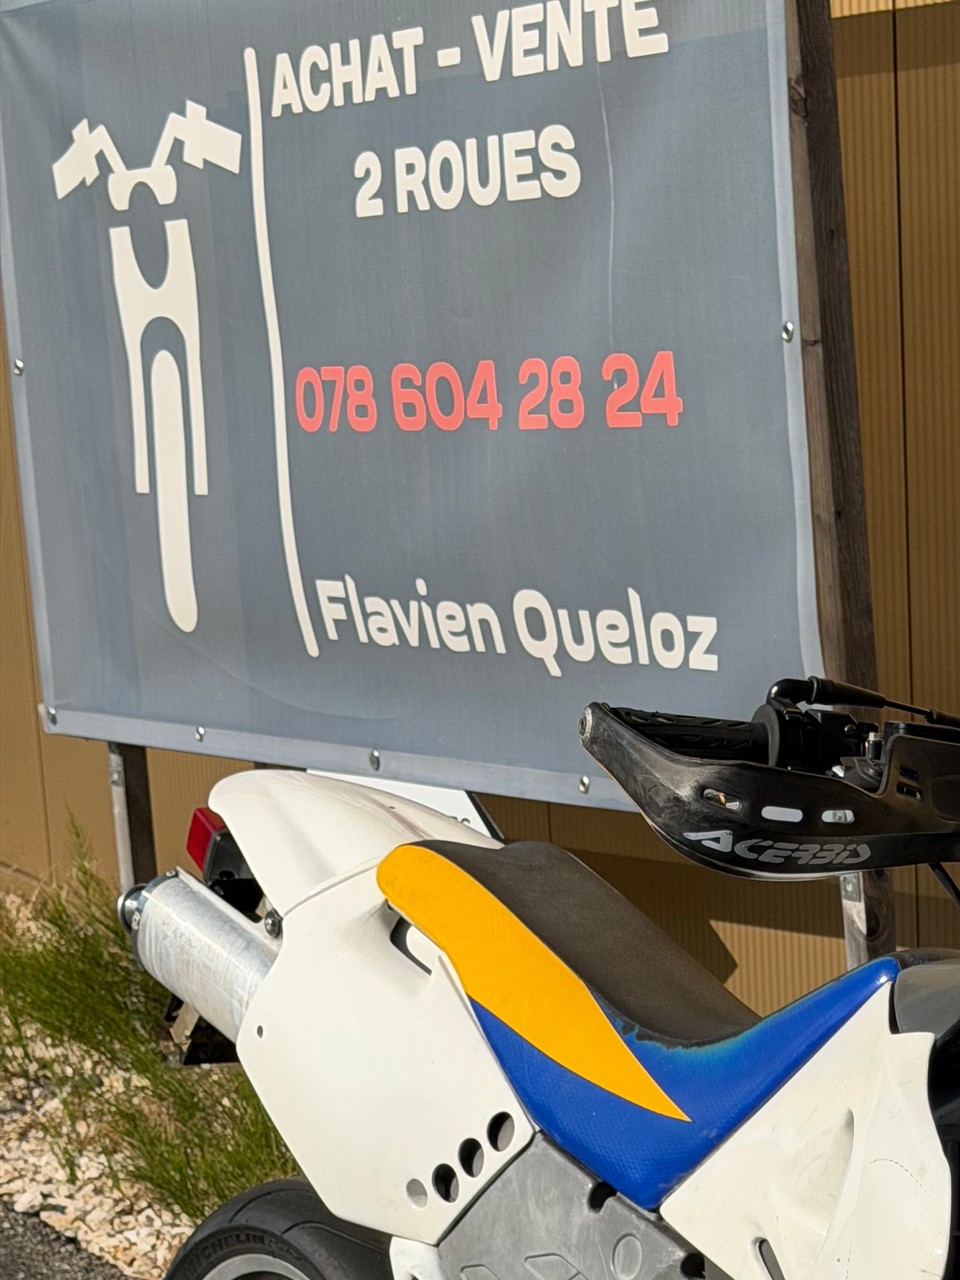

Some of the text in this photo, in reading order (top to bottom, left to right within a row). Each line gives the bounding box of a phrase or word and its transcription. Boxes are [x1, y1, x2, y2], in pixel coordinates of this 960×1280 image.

[271, 0, 669, 118] ACHAT - VENTE
[354, 124, 581, 218] 2 ROUES
[295, 350, 684, 433] 078 604 28 24
[315, 575, 718, 677] Flavien Queloz
